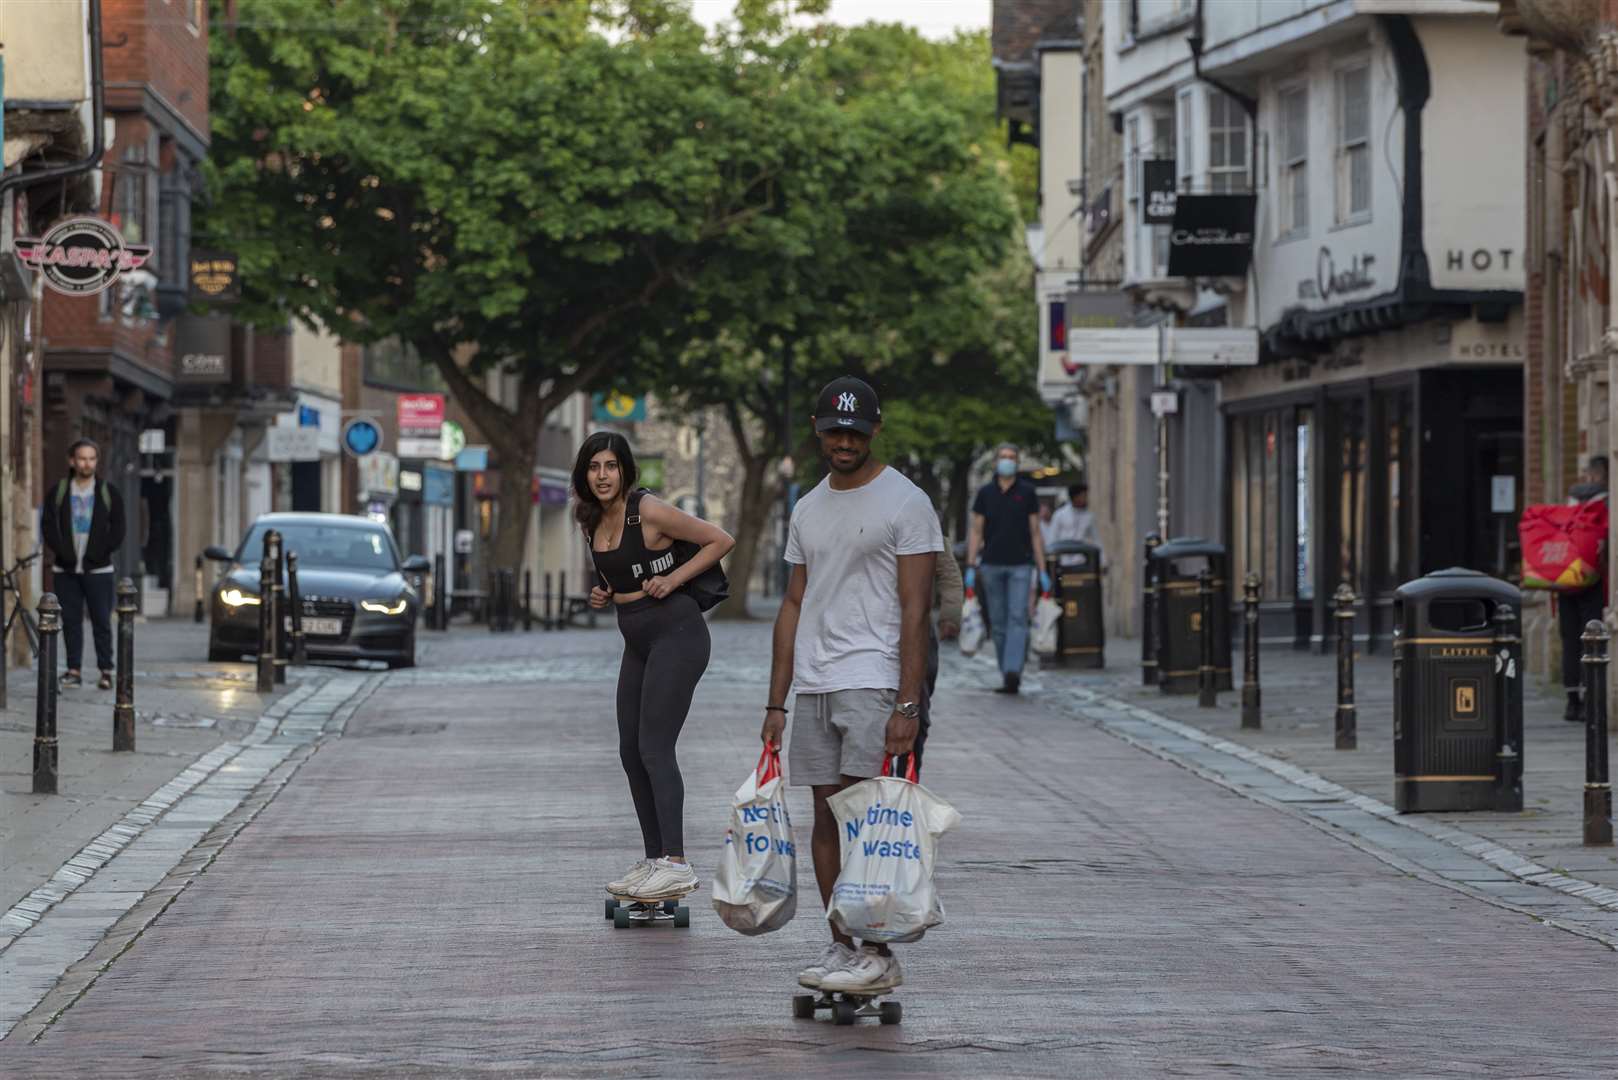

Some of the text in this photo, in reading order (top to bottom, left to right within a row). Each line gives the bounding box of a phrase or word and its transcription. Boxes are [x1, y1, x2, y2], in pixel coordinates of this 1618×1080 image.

[1446, 248, 1517, 271] HOT
[1459, 343, 1523, 357] HOTEL
[631, 551, 674, 578] PMA
[1442, 647, 1488, 657] LITTER
[846, 802, 913, 842] N time
[744, 831, 775, 855] fo
